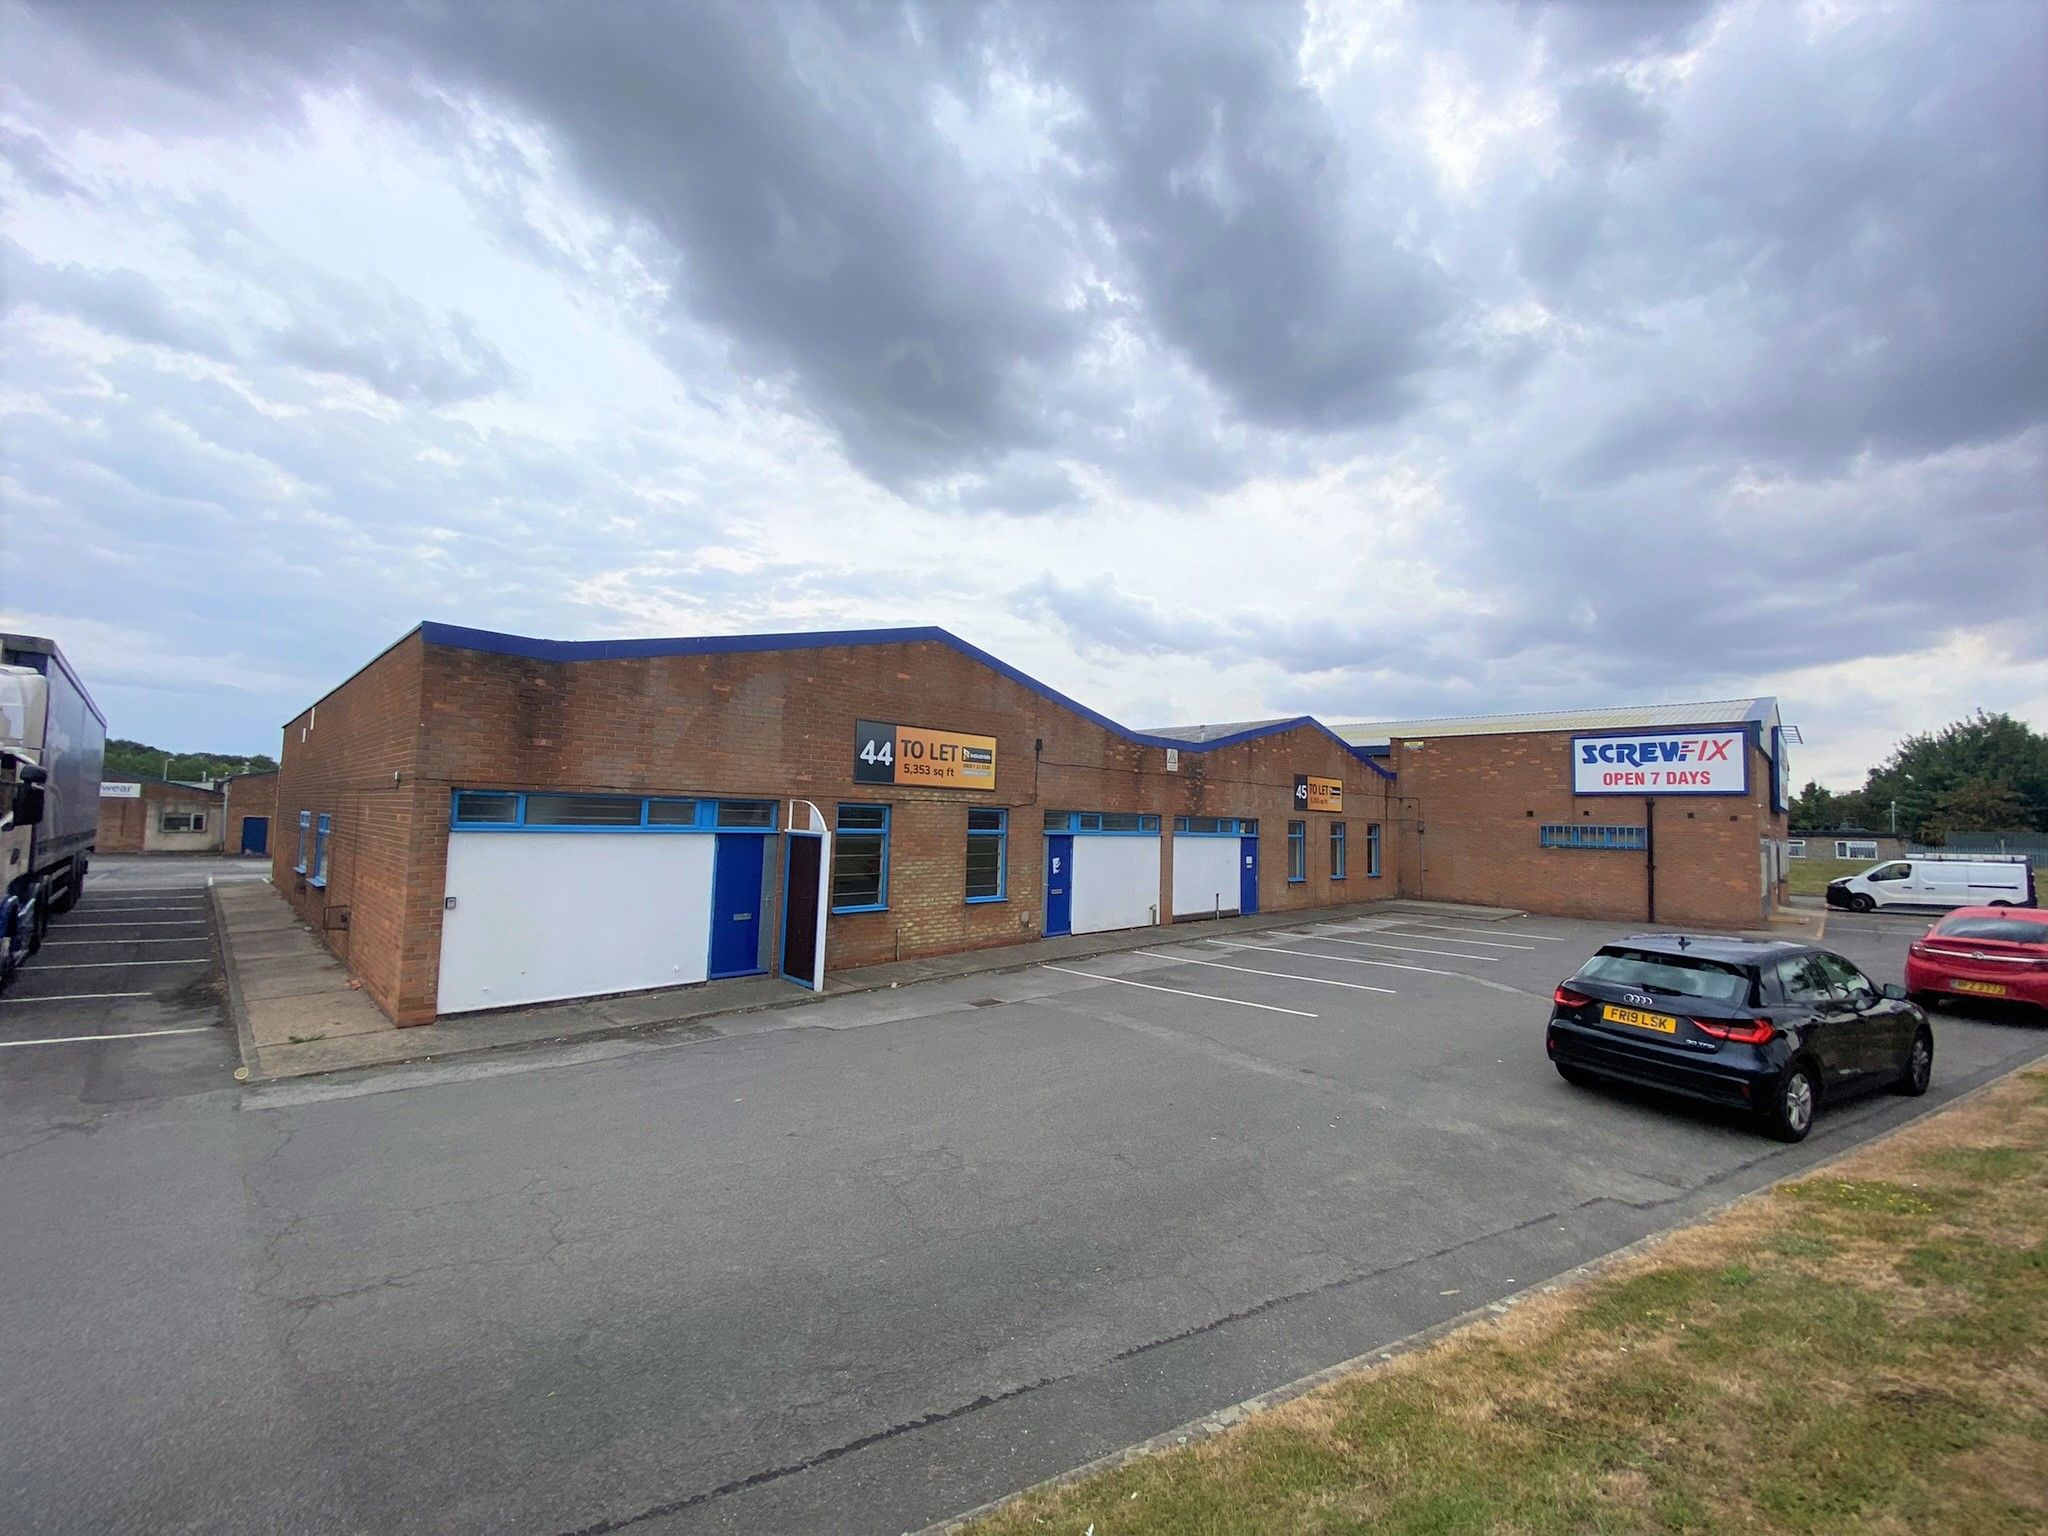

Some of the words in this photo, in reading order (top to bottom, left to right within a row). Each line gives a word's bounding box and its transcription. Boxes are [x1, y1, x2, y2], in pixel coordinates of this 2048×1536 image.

[859, 739, 893, 766] 44
[901, 739, 924, 759] TO
[930, 743, 958, 762] LET
[1582, 739, 1734, 767] SCREWFIX
[904, 763, 930, 775] 5,353
[933, 767, 944, 778] sq
[946, 766, 955, 777] ft
[1603, 772, 1645, 786] OPEN
[1651, 771, 1660, 785] 7
[1666, 771, 1711, 785] DAYS
[1295, 784, 1307, 799] 45
[1309, 784, 1318, 795] TO
[1319, 785, 1329, 796] LET
[1610, 1008, 1638, 1023] FR19
[1641, 1014, 1668, 1030] LSK
